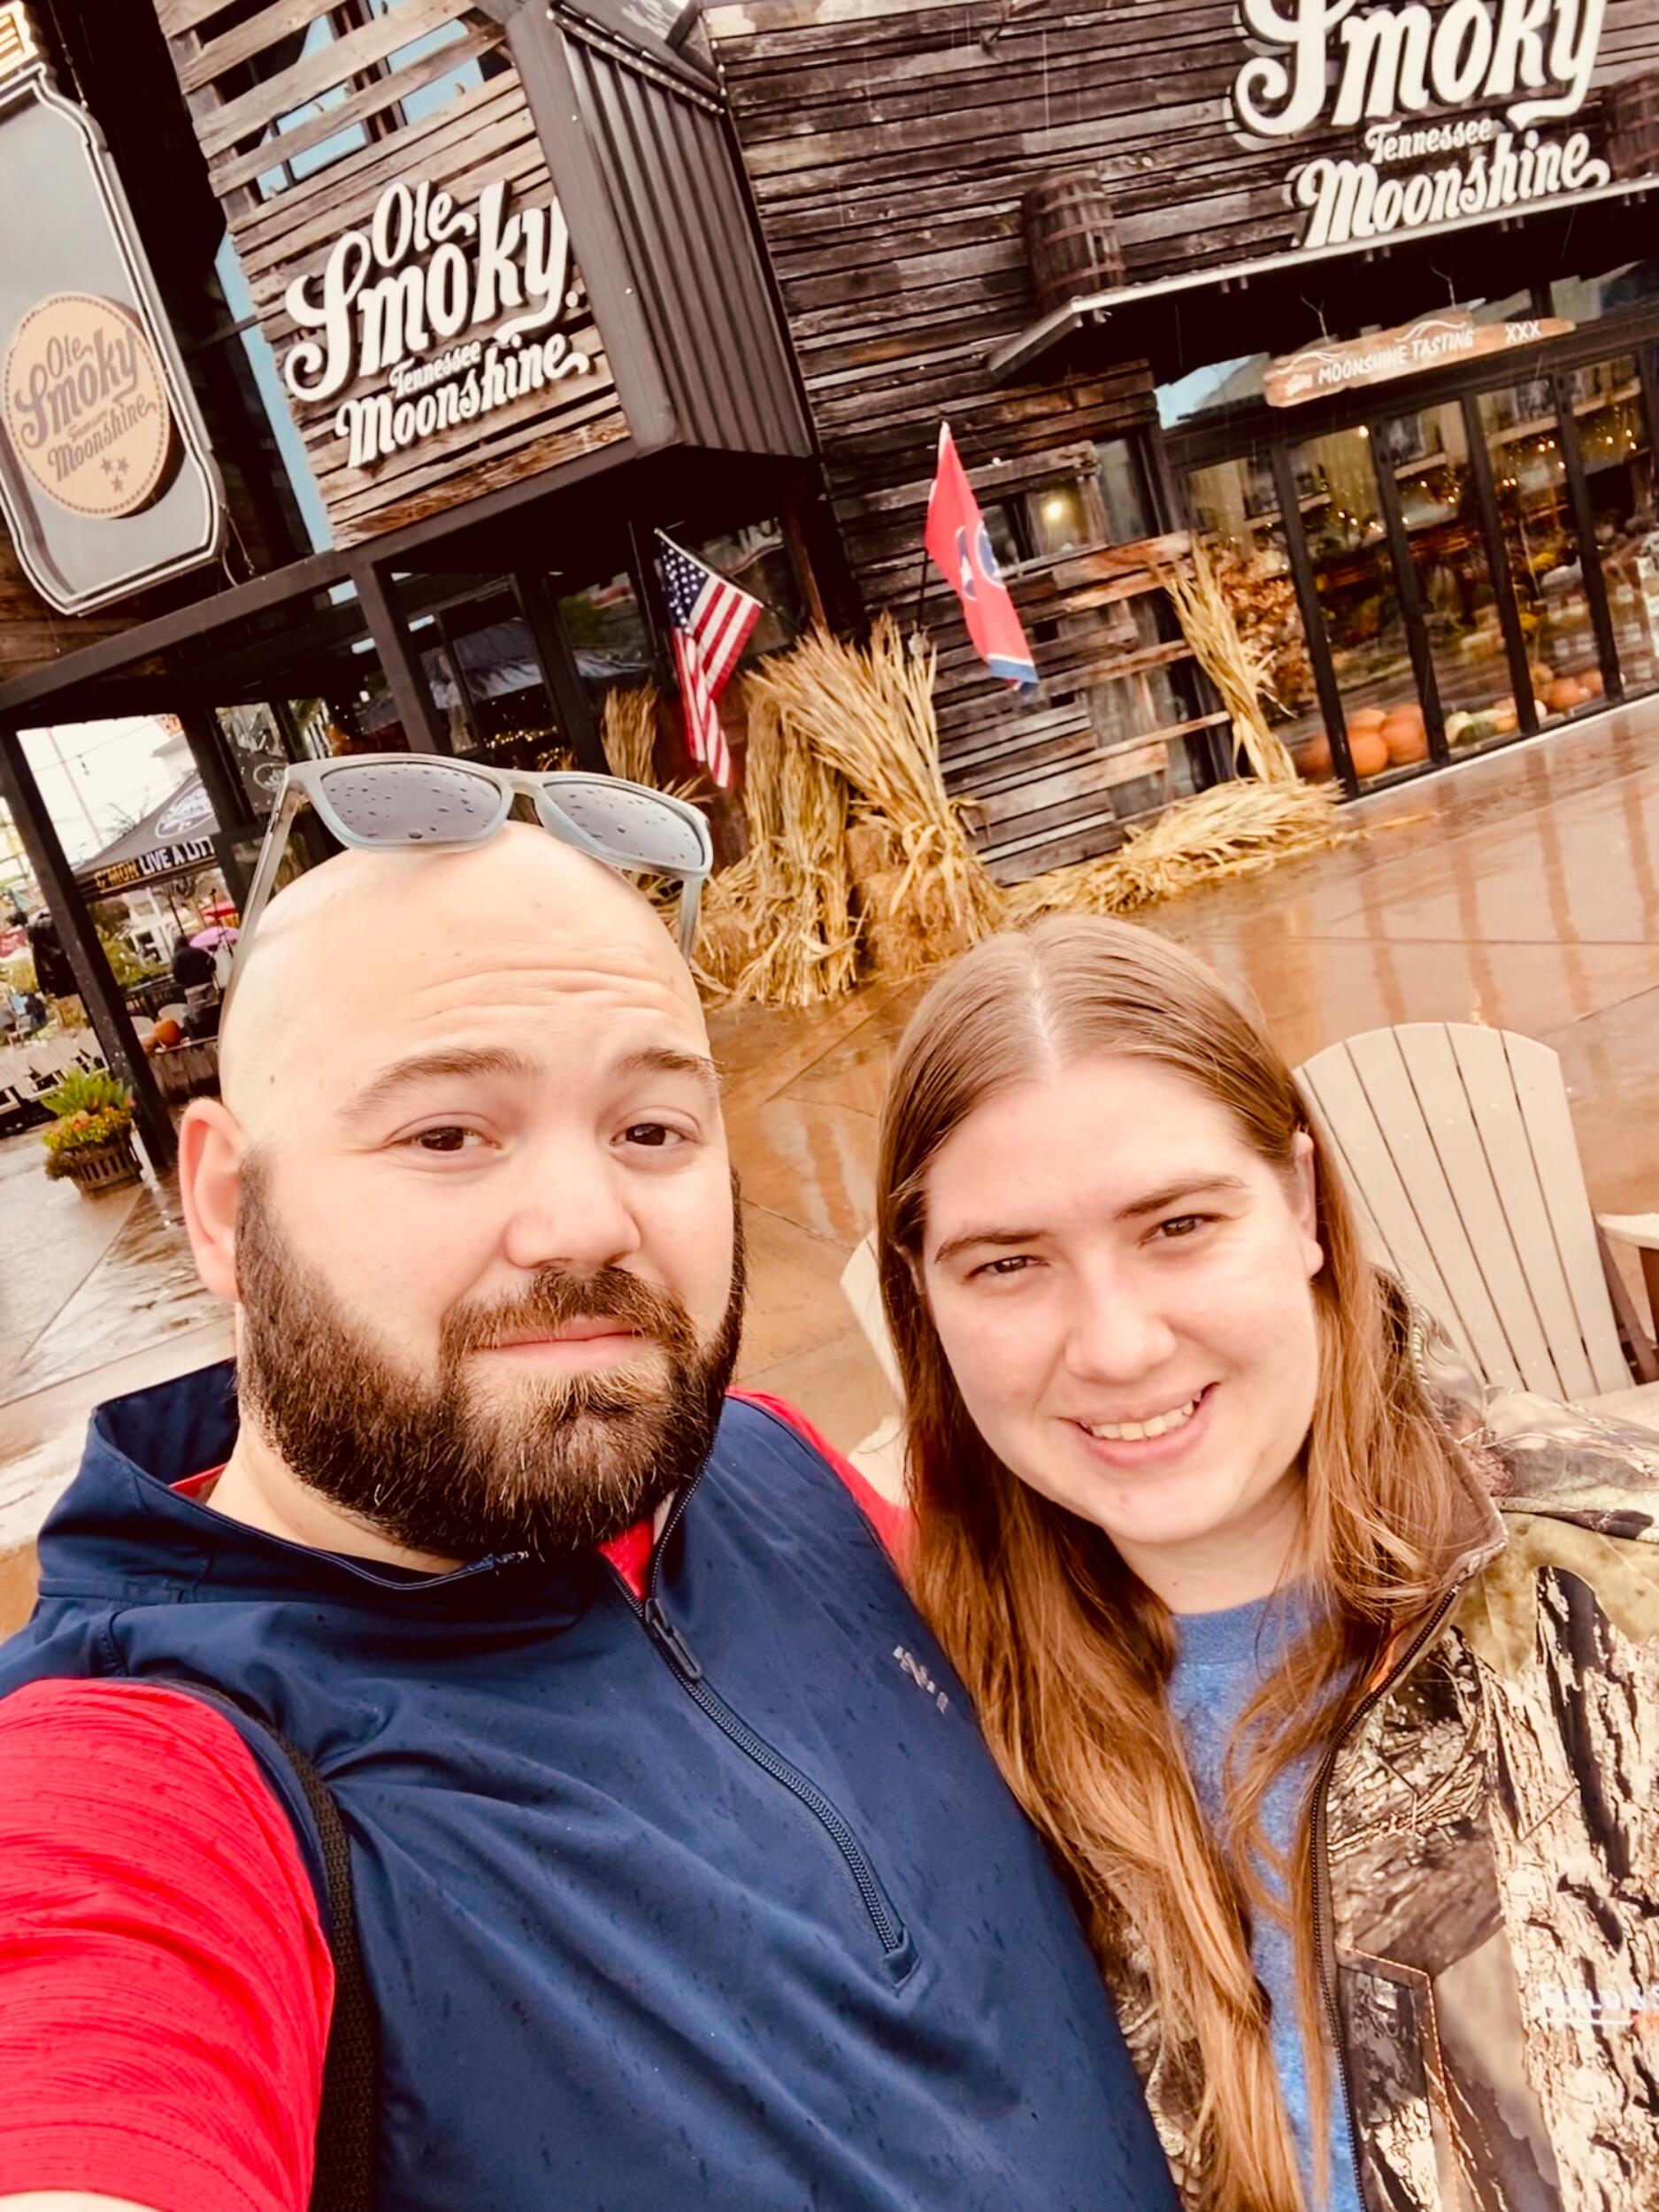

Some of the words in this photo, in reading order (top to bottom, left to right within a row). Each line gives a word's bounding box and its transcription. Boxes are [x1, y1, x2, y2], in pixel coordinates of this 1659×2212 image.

[1235, 0, 1607, 135] Smoky
[1364, 118, 1493, 164] Tennessee
[372, 180, 476, 267] Ole
[1296, 130, 1610, 249] Moonshine
[14, 326, 138, 449] Smoky
[47, 334, 93, 379] Ole
[389, 341, 481, 397] Tennessee
[1317, 345, 1408, 385] MOONSHINE
[1412, 328, 1475, 360] TASTING
[1504, 320, 1541, 344] XXX
[48, 395, 157, 482] Moonshine
[334, 333, 590, 468] Moonshine
[138, 850, 173, 876] LIVE
[172, 845, 185, 866] A
